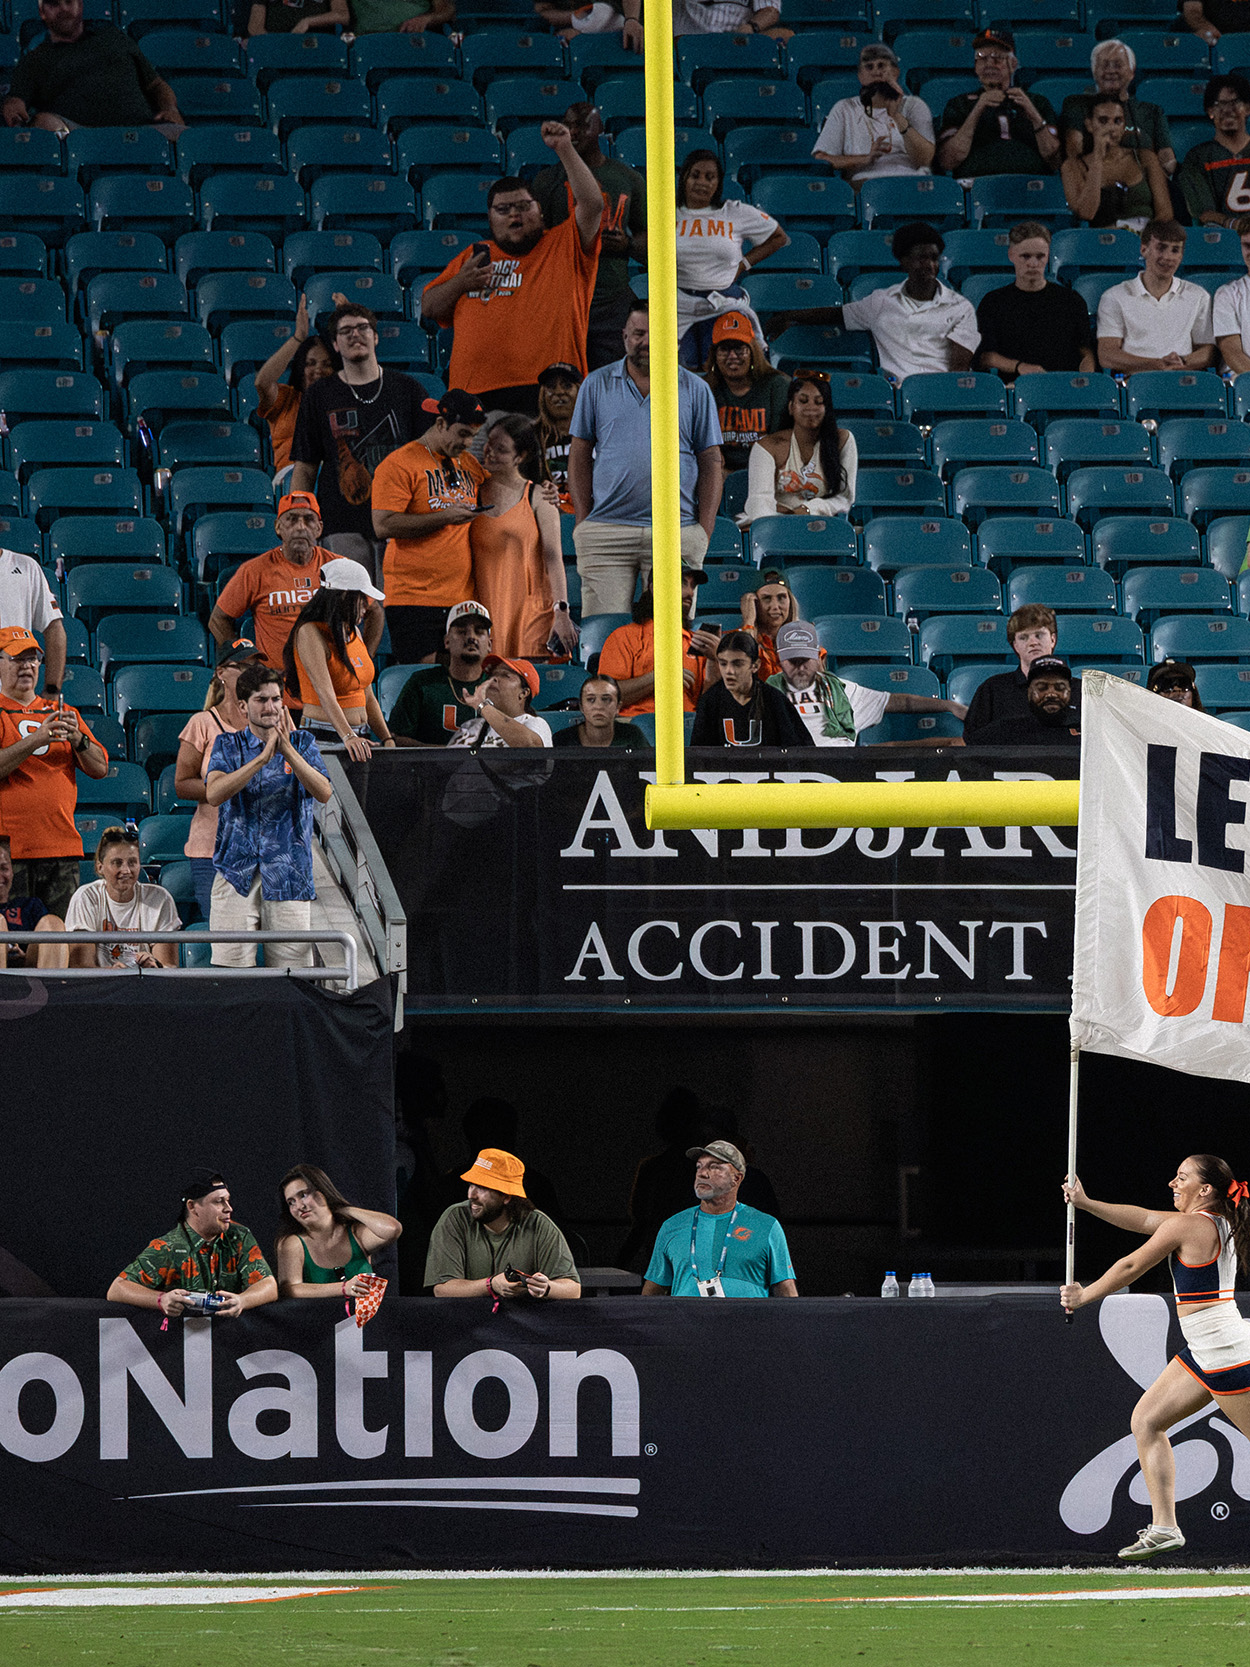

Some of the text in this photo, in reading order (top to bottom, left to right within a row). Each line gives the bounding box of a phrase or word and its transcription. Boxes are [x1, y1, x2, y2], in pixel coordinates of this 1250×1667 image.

[675, 218, 734, 241] IAMI
[722, 717, 763, 747] U
[564, 920, 1049, 981] ACCIDENT
